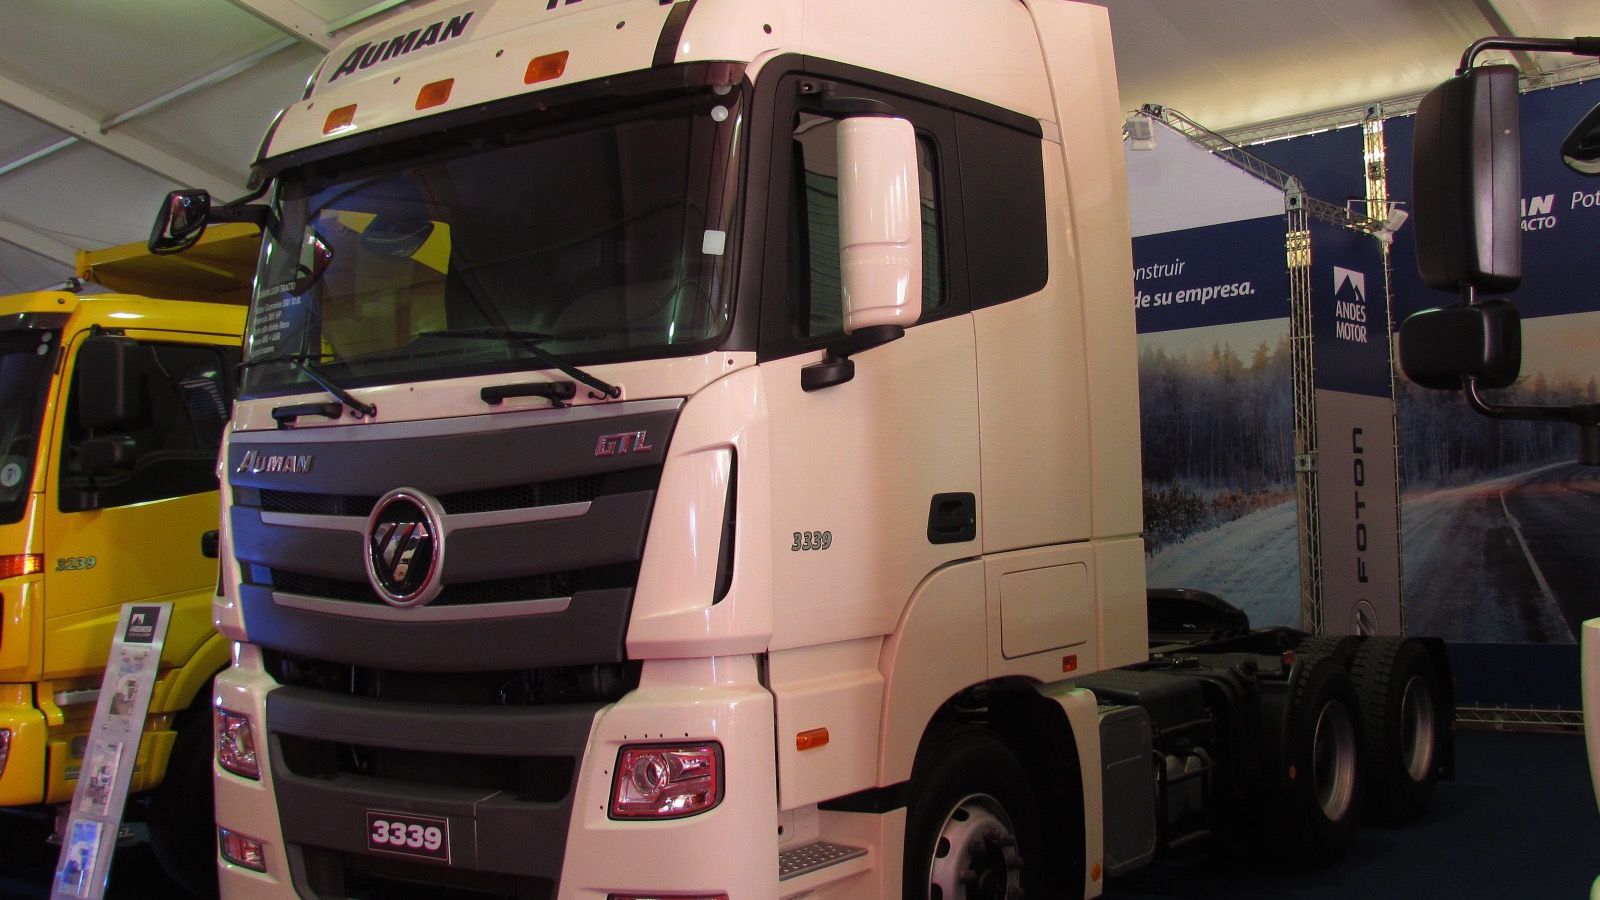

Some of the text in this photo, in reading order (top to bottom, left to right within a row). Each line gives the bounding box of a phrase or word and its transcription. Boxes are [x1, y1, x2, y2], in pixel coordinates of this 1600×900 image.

[328, 11, 475, 84] AUMAN
[1133, 258, 1186, 281] nstruir
[1153, 291, 1173, 307] su
[1175, 281, 1256, 305] empresa.
[1335, 299, 1367, 323] ANDES
[1336, 320, 1368, 344] MOTOR
[594, 429, 653, 458] GTL
[237, 450, 312, 474] AUMAN
[1352, 427, 1369, 583] FOTON
[791, 530, 833, 552] 3339
[55, 555, 96, 572] 3239
[372, 820, 442, 850] 3339
